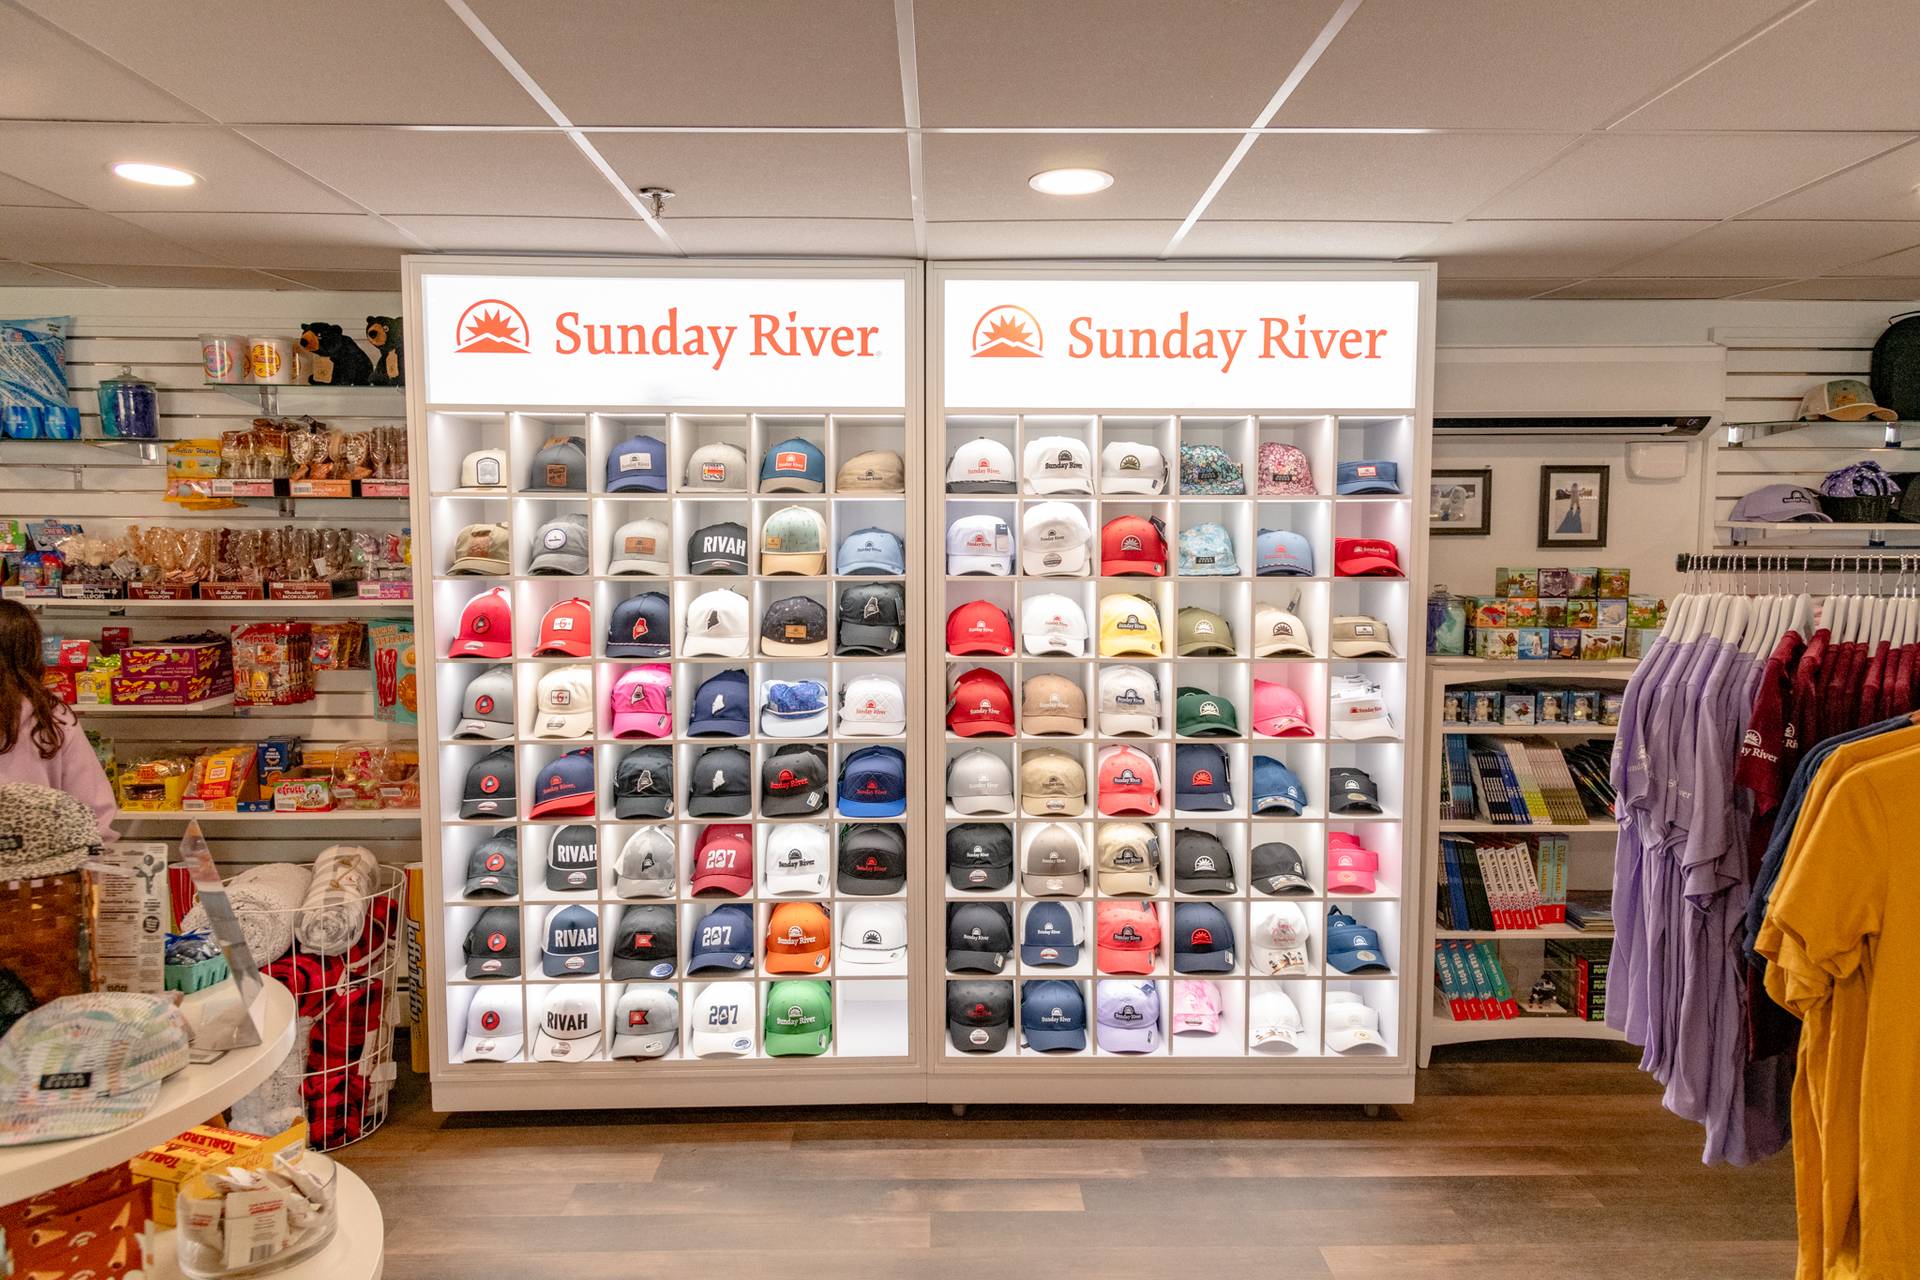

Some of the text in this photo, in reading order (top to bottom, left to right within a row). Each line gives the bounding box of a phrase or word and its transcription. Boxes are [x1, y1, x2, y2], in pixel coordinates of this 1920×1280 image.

[555, 307, 879, 371] Sunday River
[1068, 311, 1388, 373] Sunday River
[1045, 462, 1068, 470] Sunday
[703, 535, 747, 557] RIVAH
[1752, 747, 1779, 763] River
[770, 778, 809, 790] Sunday River
[557, 844, 598, 863] RIVAH
[705, 849, 737, 870] 207
[778, 859, 815, 869] Sunday River
[555, 927, 597, 948] RIVAH
[702, 926, 732, 947] 207
[777, 936, 817, 946] Sunday River
[547, 1011, 588, 1031] RIVAH
[708, 1004, 739, 1026] 207
[776, 1016, 816, 1027] Sunday River
